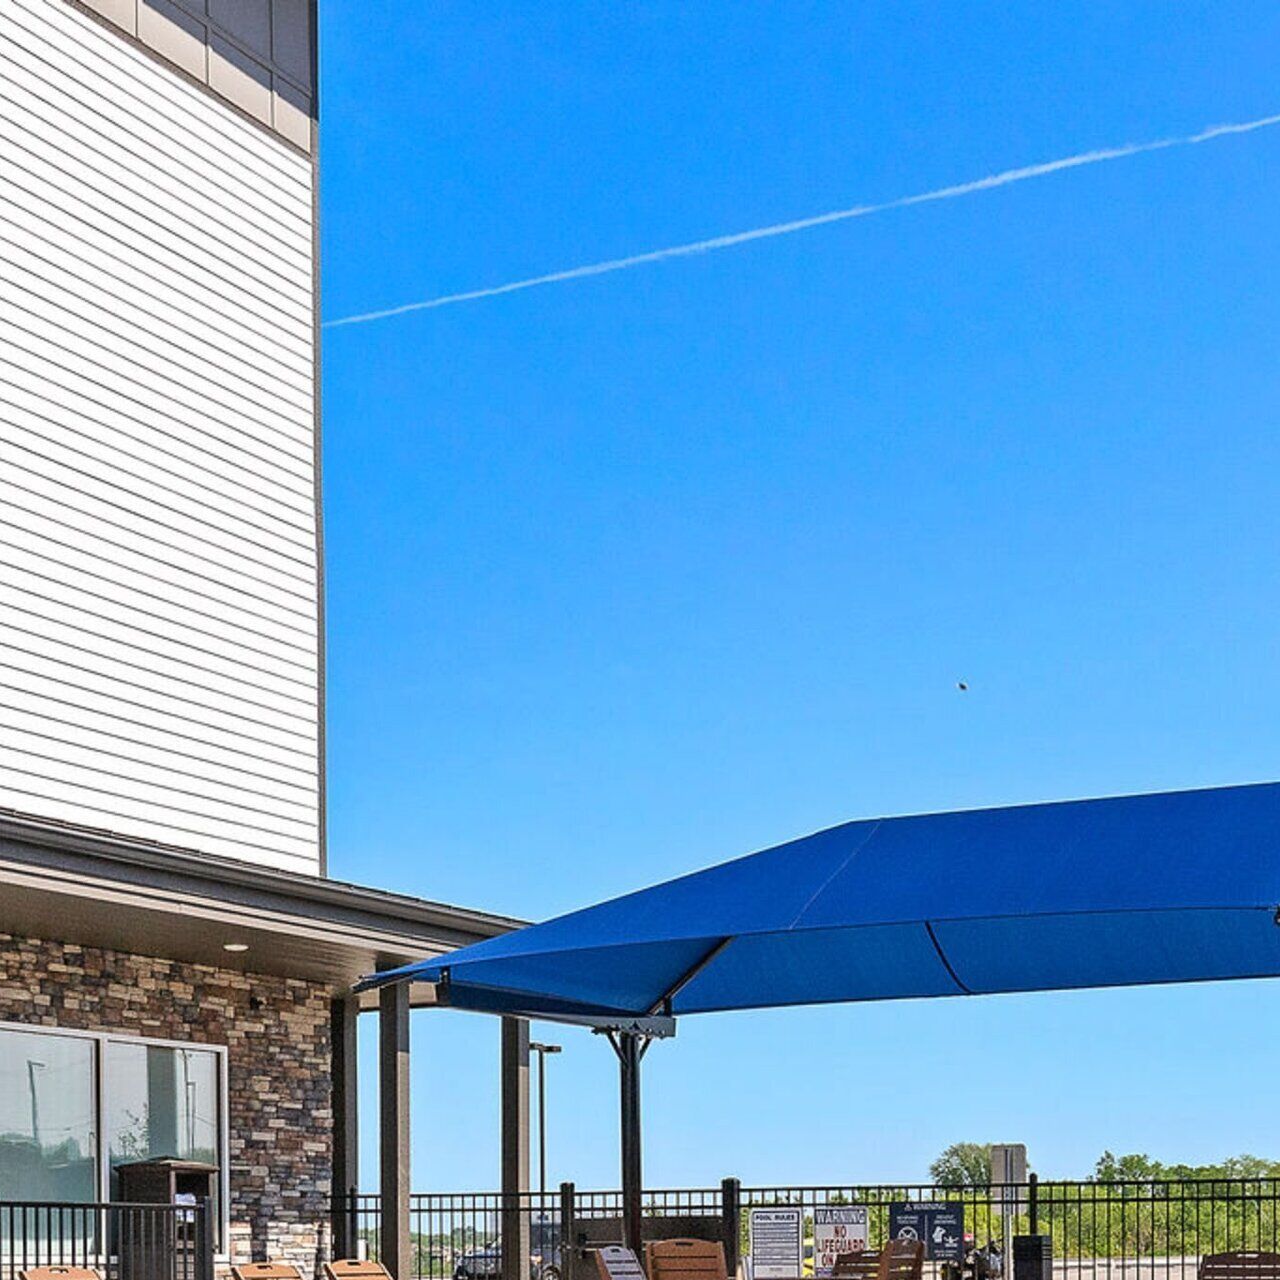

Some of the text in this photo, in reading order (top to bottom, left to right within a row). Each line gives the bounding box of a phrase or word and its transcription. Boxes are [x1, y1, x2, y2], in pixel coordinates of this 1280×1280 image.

[815, 1210, 866, 1225] WARNING
[834, 1225, 847, 1238] NO
[816, 1239, 865, 1253] LIFEGUARD
